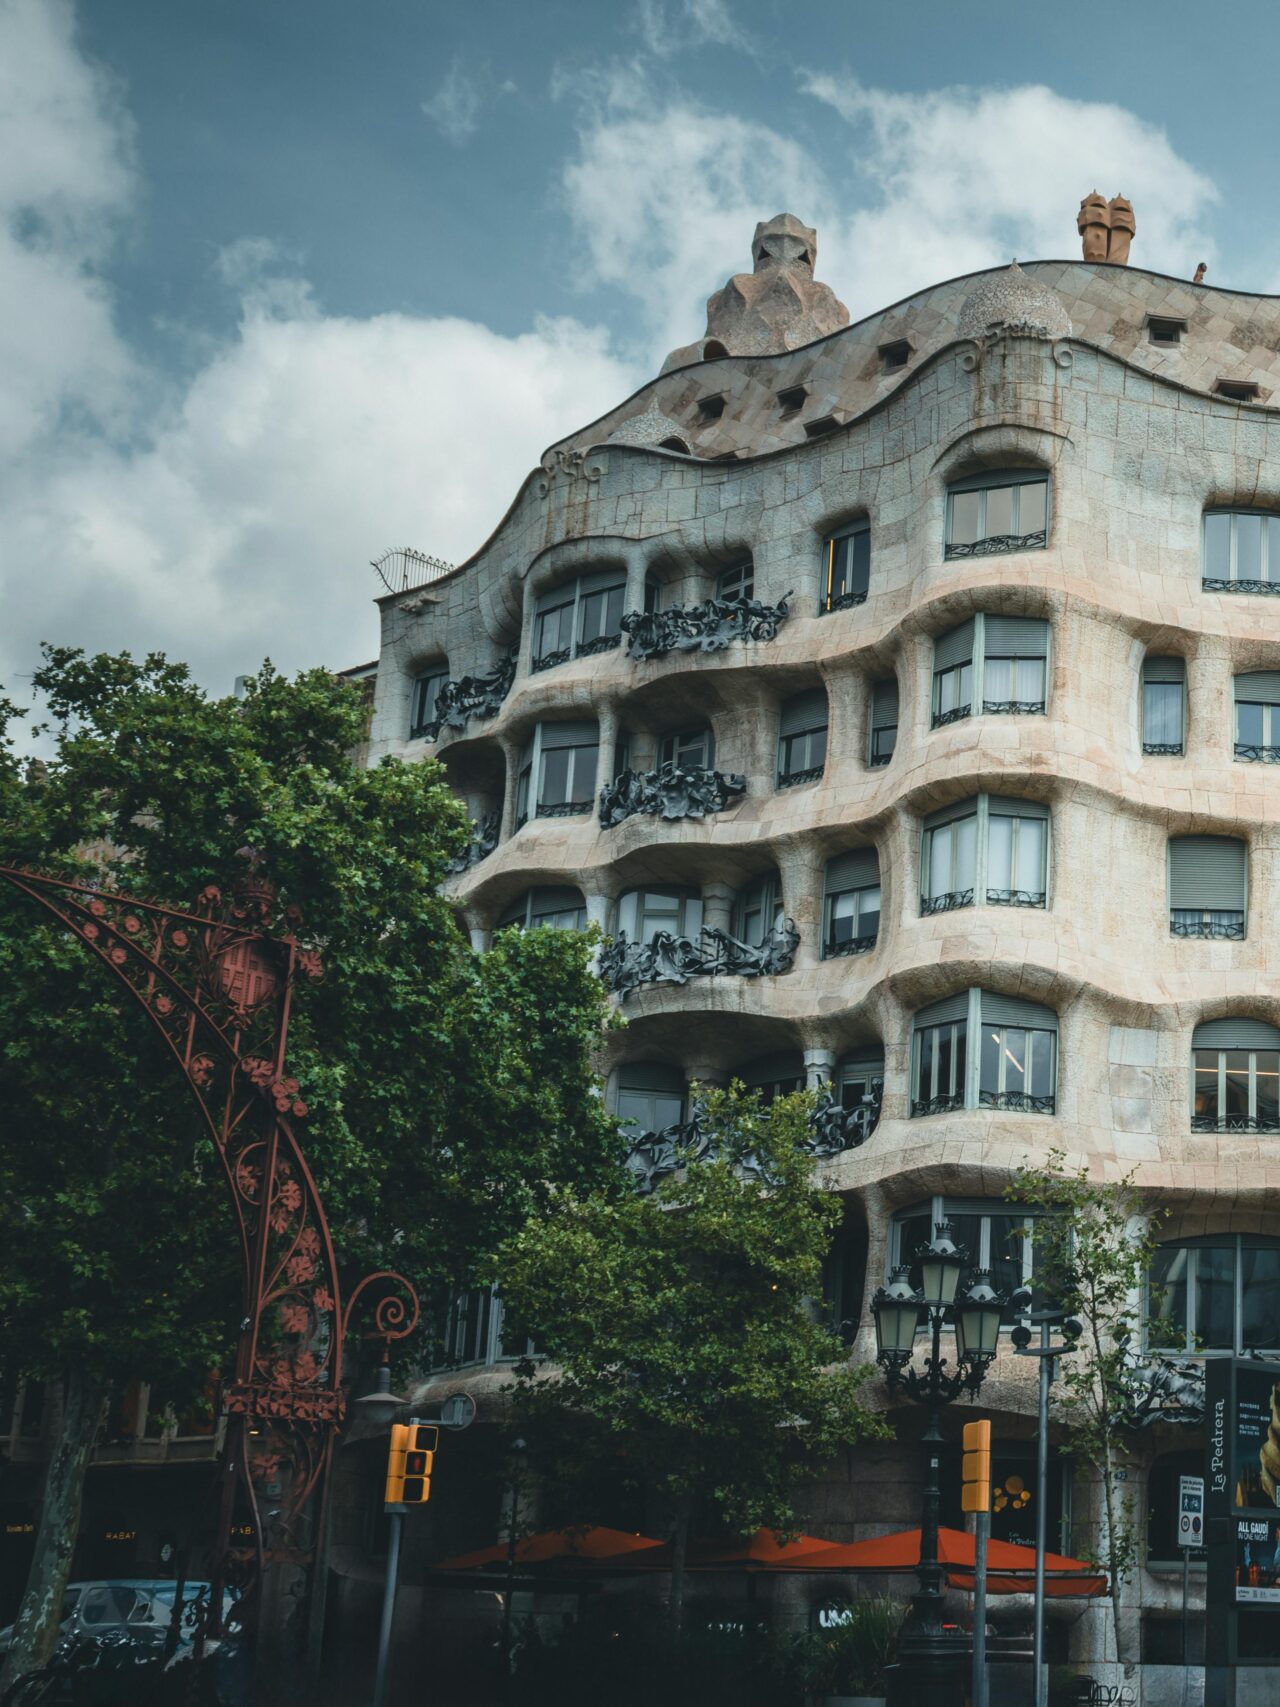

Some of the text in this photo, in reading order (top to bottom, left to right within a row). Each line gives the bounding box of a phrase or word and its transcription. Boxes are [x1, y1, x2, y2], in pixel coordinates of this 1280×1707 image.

[1211, 1398, 1226, 1493] La Pedrera
[1238, 1521, 1250, 1533] ALL
[105, 1531, 136, 1540] RABAT
[1254, 1534, 1268, 1542] NIGHT
